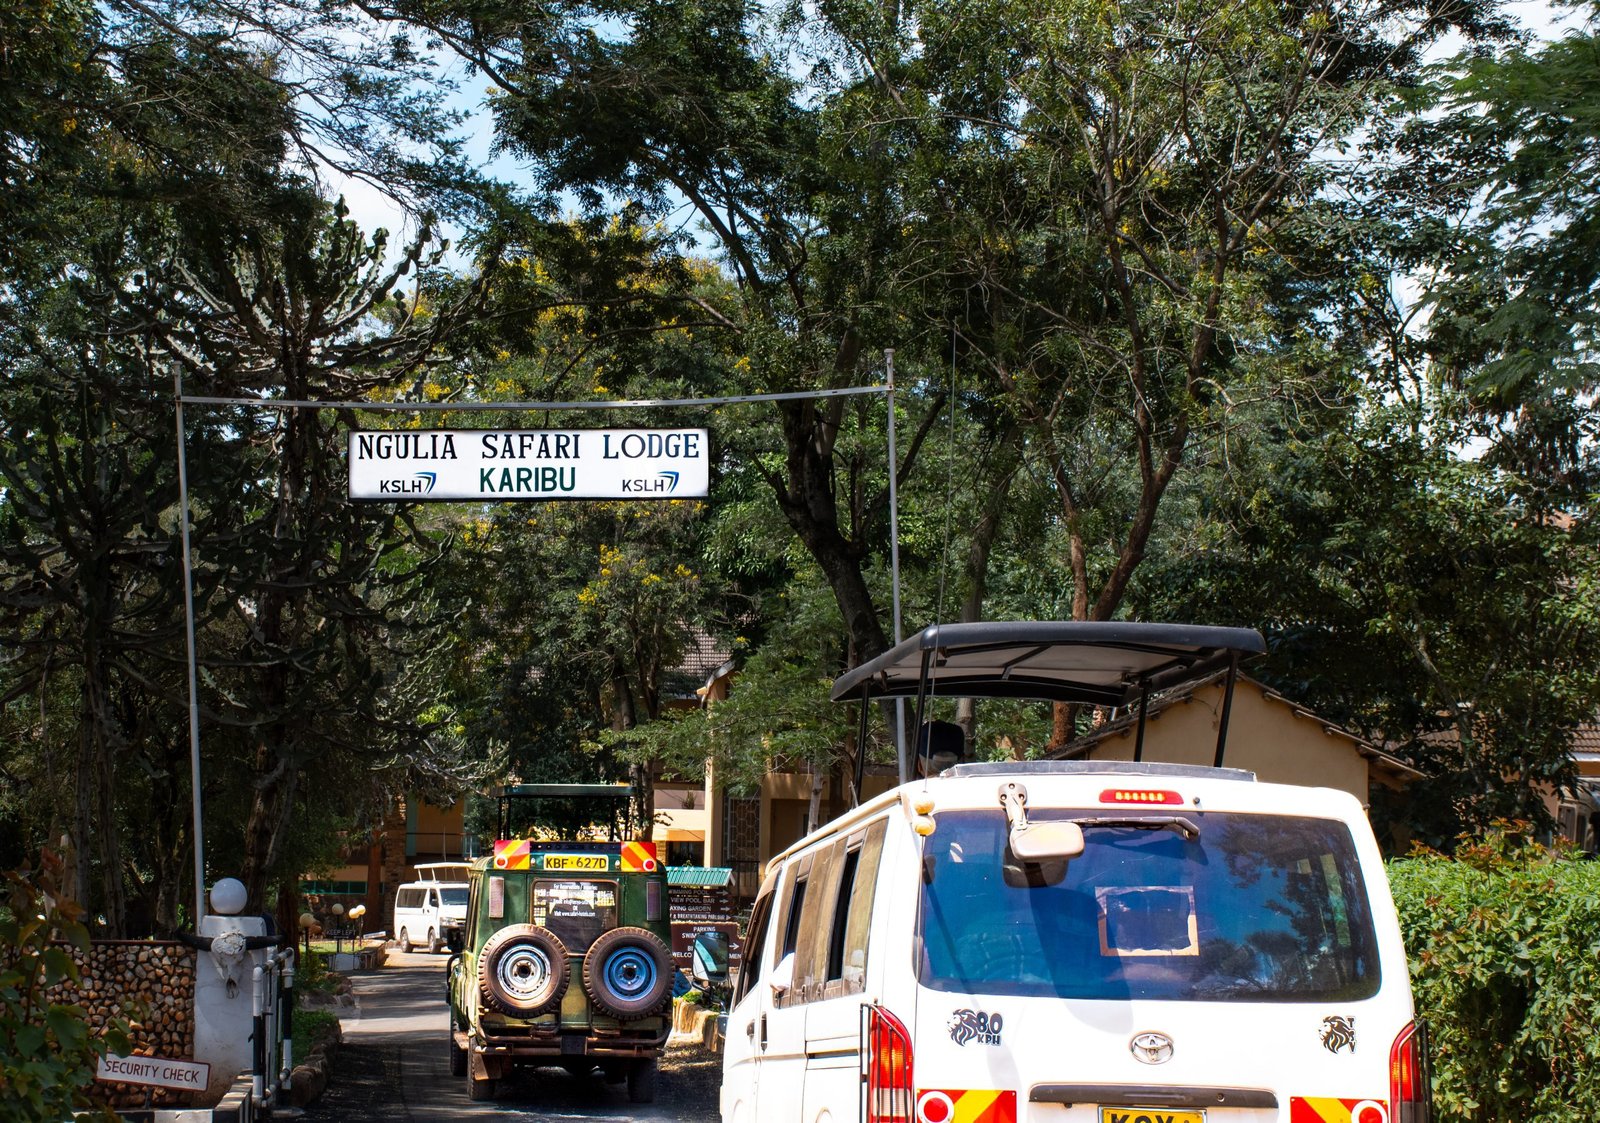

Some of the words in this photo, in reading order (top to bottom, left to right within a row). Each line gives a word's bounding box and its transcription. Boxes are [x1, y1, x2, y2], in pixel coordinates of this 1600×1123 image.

[358, 434, 458, 460] NGULIA
[482, 433, 581, 459] SAFARI
[602, 433, 700, 459] LODGE
[380, 479, 422, 493] KSLH
[480, 466, 576, 493] KARIBU
[622, 479, 664, 492] KSLH
[545, 857, 569, 869] KBF
[576, 857, 607, 869] 627D
[977, 1011, 1003, 1034] 80
[977, 1033, 1001, 1045] KPH
[104, 1060, 160, 1078] SECURITY
[162, 1067, 200, 1083] CHECK
